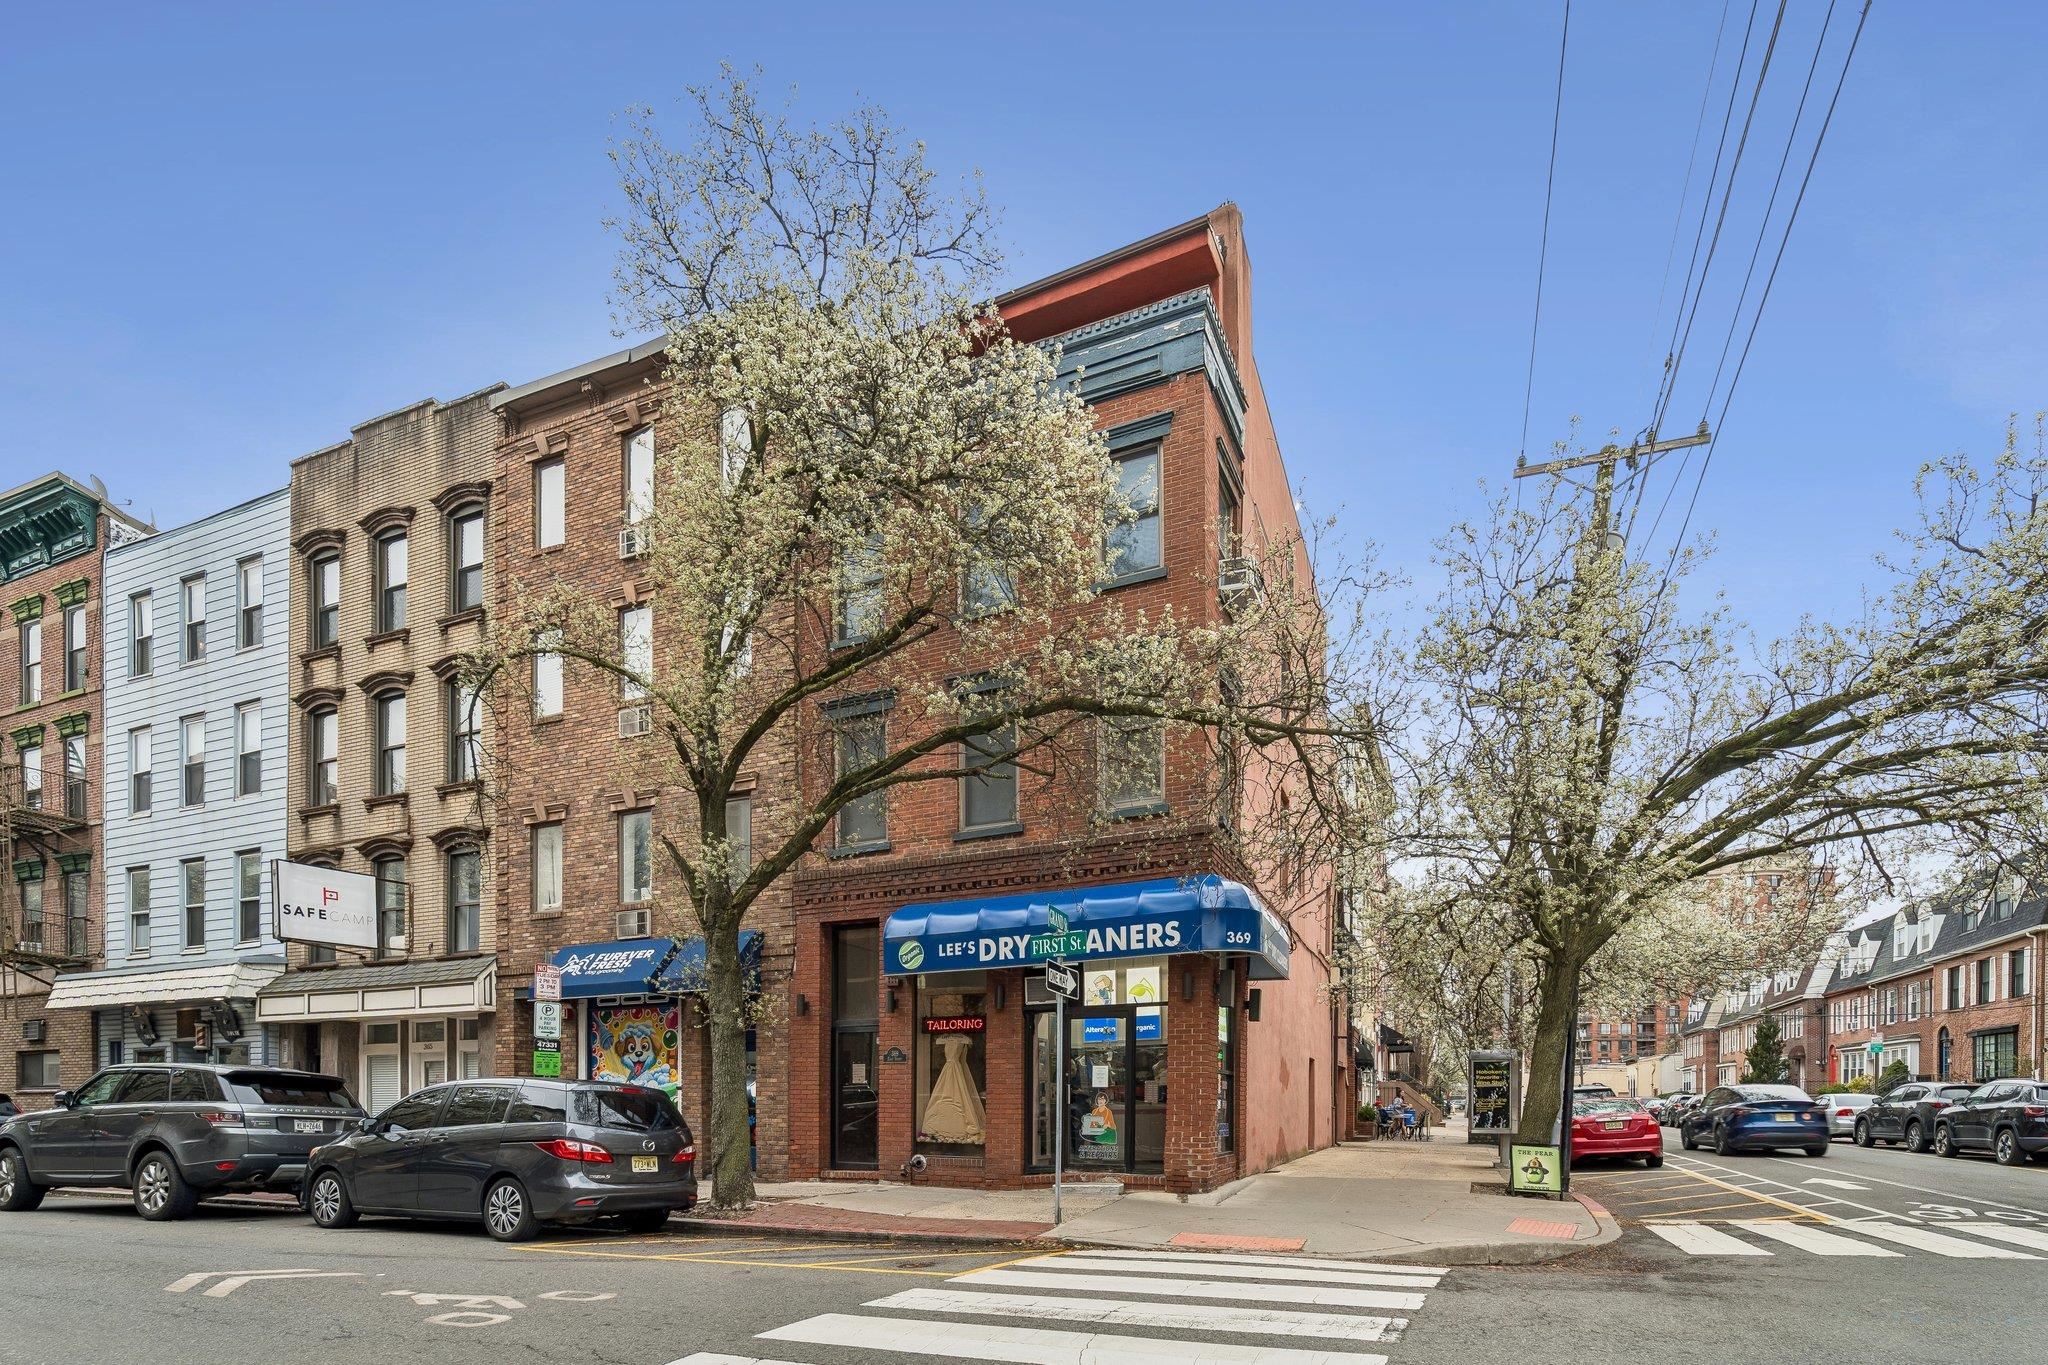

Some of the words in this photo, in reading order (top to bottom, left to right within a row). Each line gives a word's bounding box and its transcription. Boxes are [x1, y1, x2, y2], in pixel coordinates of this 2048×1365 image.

[938, 941, 976, 957] LEE'S
[979, 934, 1031, 962] DRY
[1085, 920, 1181, 954] ANERS
[1226, 931, 1251, 944] 369
[1032, 937, 1067, 955] FIRST
[1070, 935, 1086, 951] St.
[595, 949, 655, 961] FUREVER
[537, 964, 547, 973] NO
[926, 1019, 983, 1031] TAILORING
[1085, 1026, 1116, 1034] Alteran
[1136, 1023, 1156, 1033] rganic
[537, 1040, 558, 1049] 47331
[1087, 1151, 1118, 1160] REPAIRS
